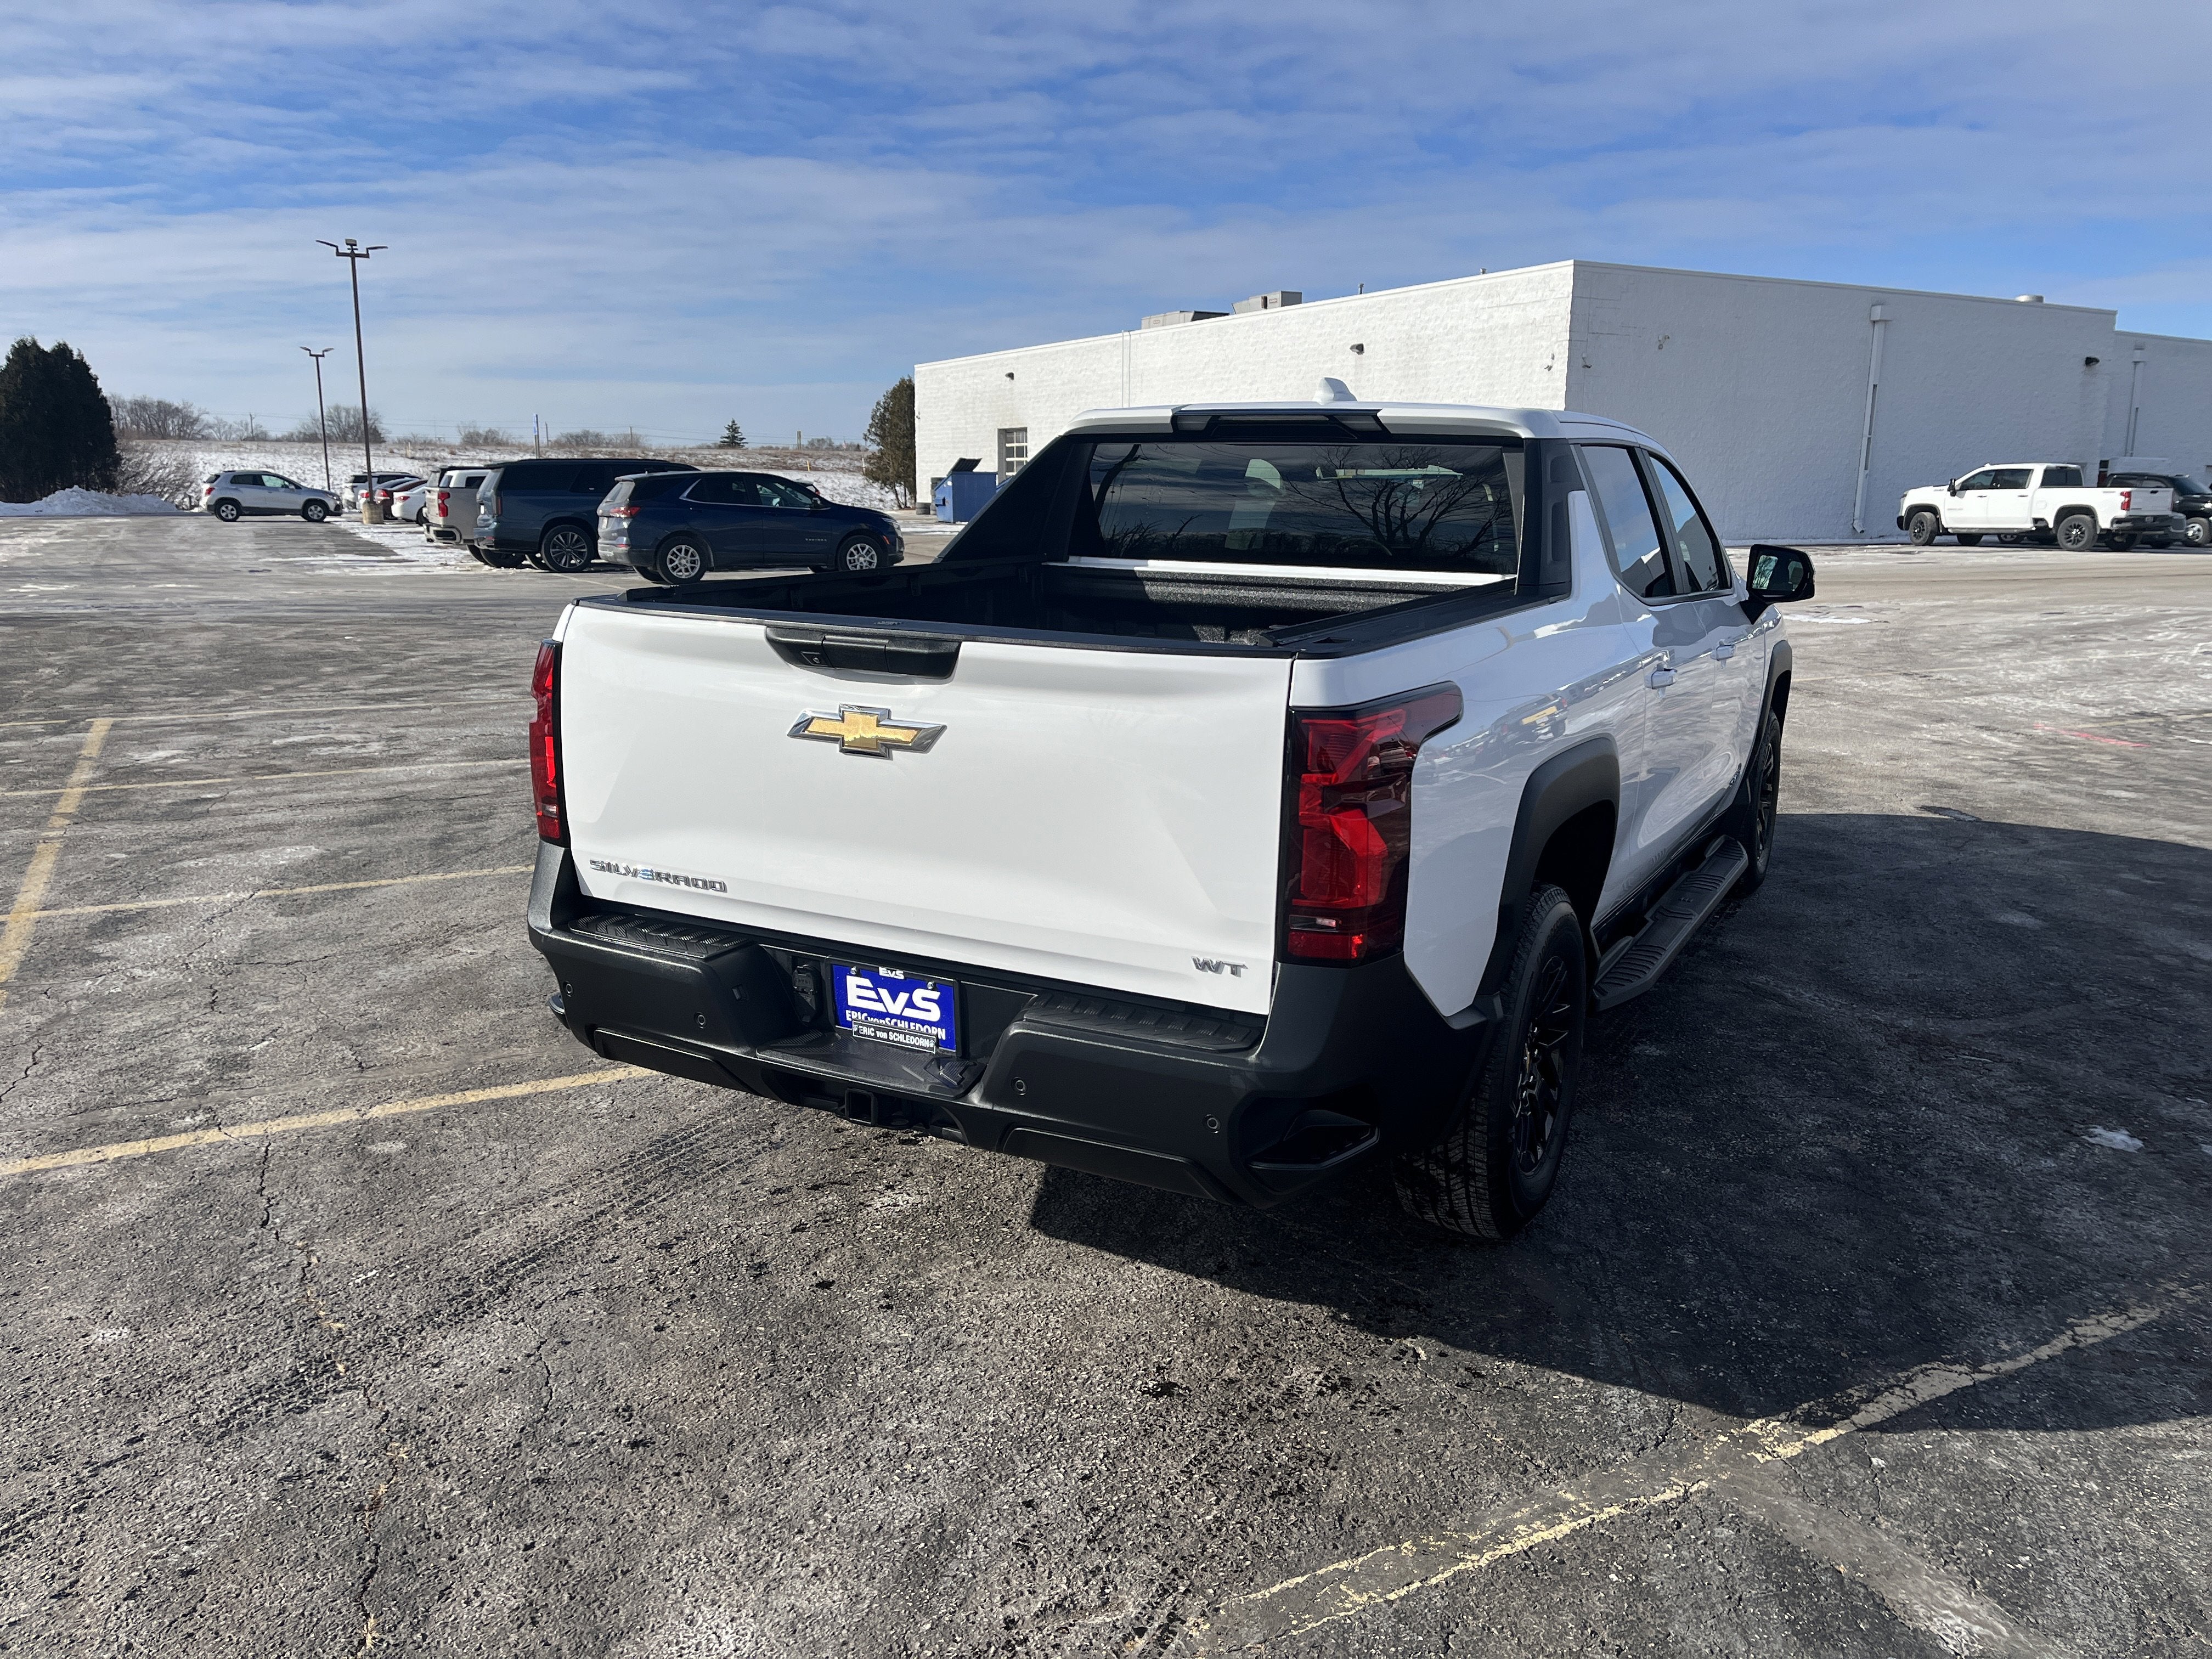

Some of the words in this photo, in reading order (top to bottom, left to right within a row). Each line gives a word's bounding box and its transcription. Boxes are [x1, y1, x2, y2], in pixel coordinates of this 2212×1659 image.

[589, 859, 727, 893] SILVERADO
[1191, 956, 1249, 978] WT
[846, 975, 941, 1022] EvS
[859, 1025, 874, 1036] ERIC
[876, 1030, 888, 1039] von
[889, 1031, 929, 1048] SCHLEDORN
